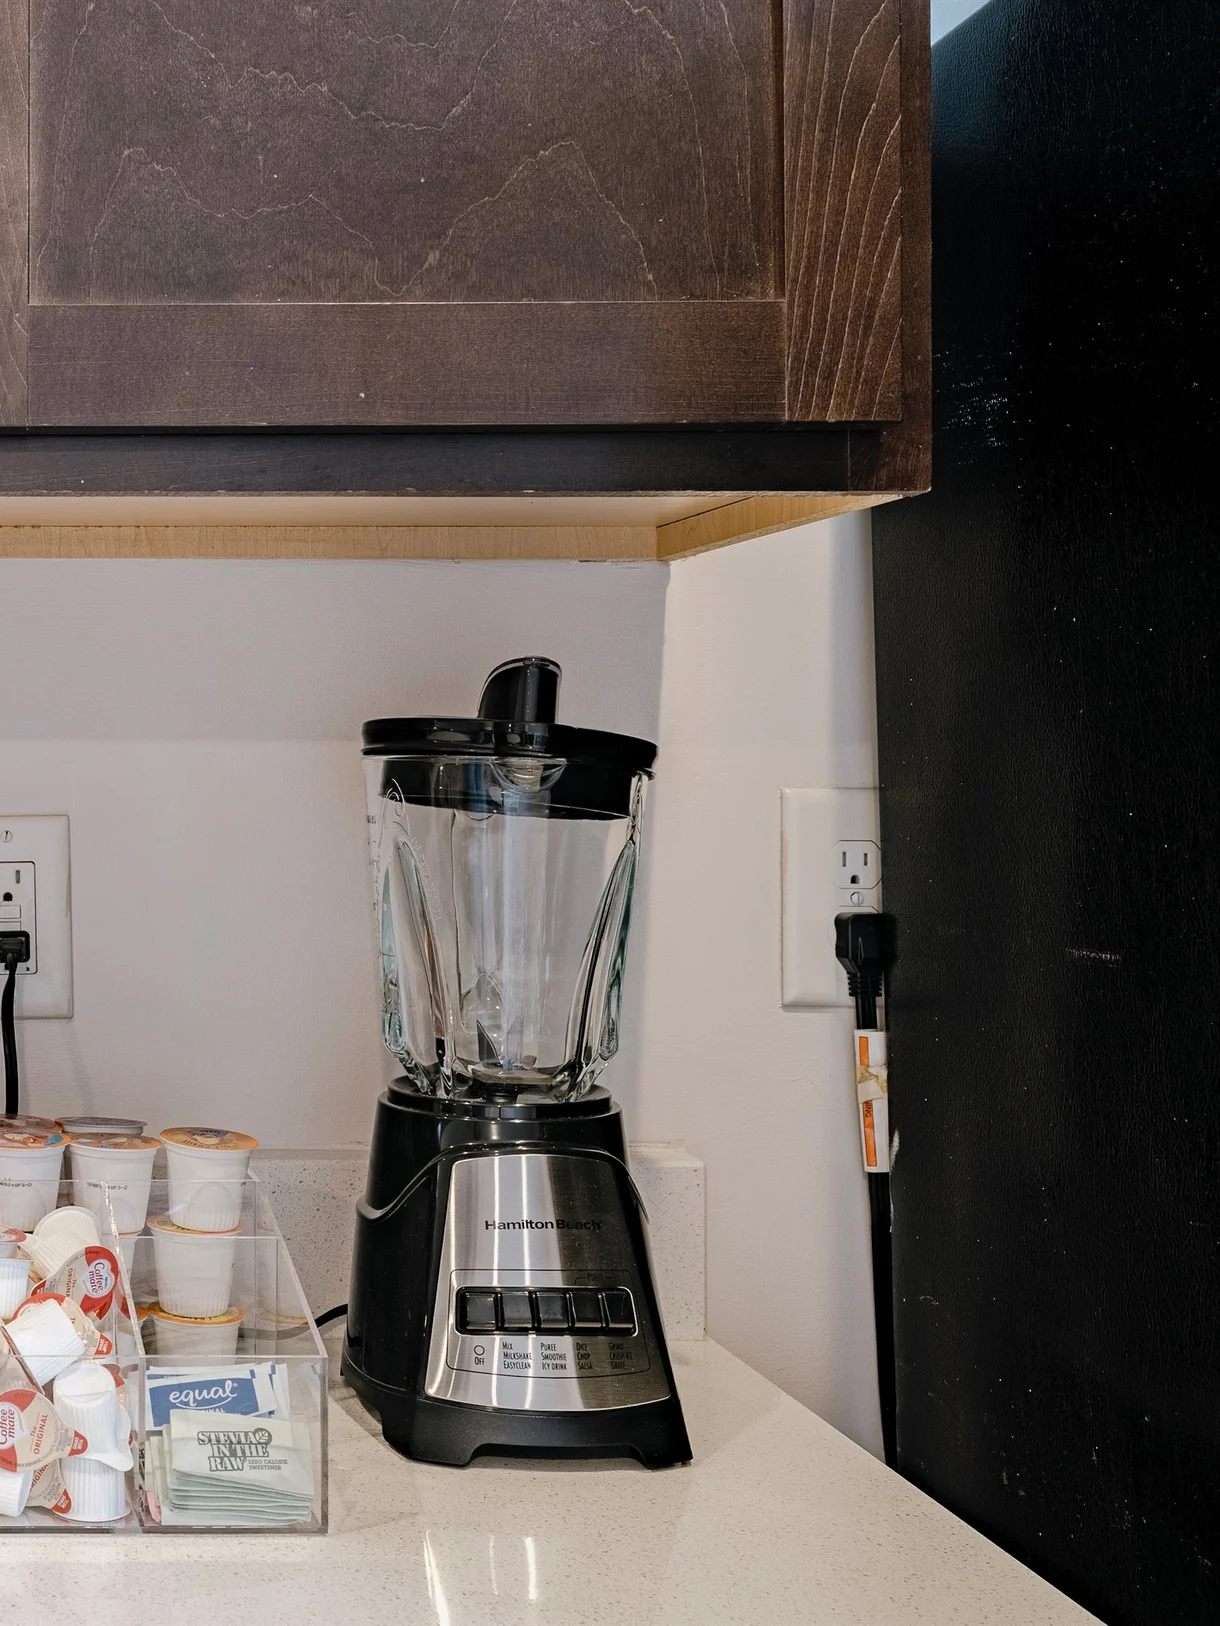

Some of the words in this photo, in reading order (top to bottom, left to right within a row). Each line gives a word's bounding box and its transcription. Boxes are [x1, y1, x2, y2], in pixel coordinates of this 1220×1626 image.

[484, 1219, 554, 1230] Hamilton
[555, 1219, 601, 1230] Beach
[88, 1270, 98, 1293] mate
[93, 1262, 105, 1291] Coffee
[169, 1380, 238, 1407] equal
[7, 1408, 16, 1439] mate
[29, 1425, 38, 1437] The
[33, 1413, 49, 1455] ORIGINAL
[197, 1431, 255, 1445] STEVIA
[210, 1443, 233, 1458] IN
[233, 1443, 270, 1458] THE
[208, 1456, 245, 1472] RAW
